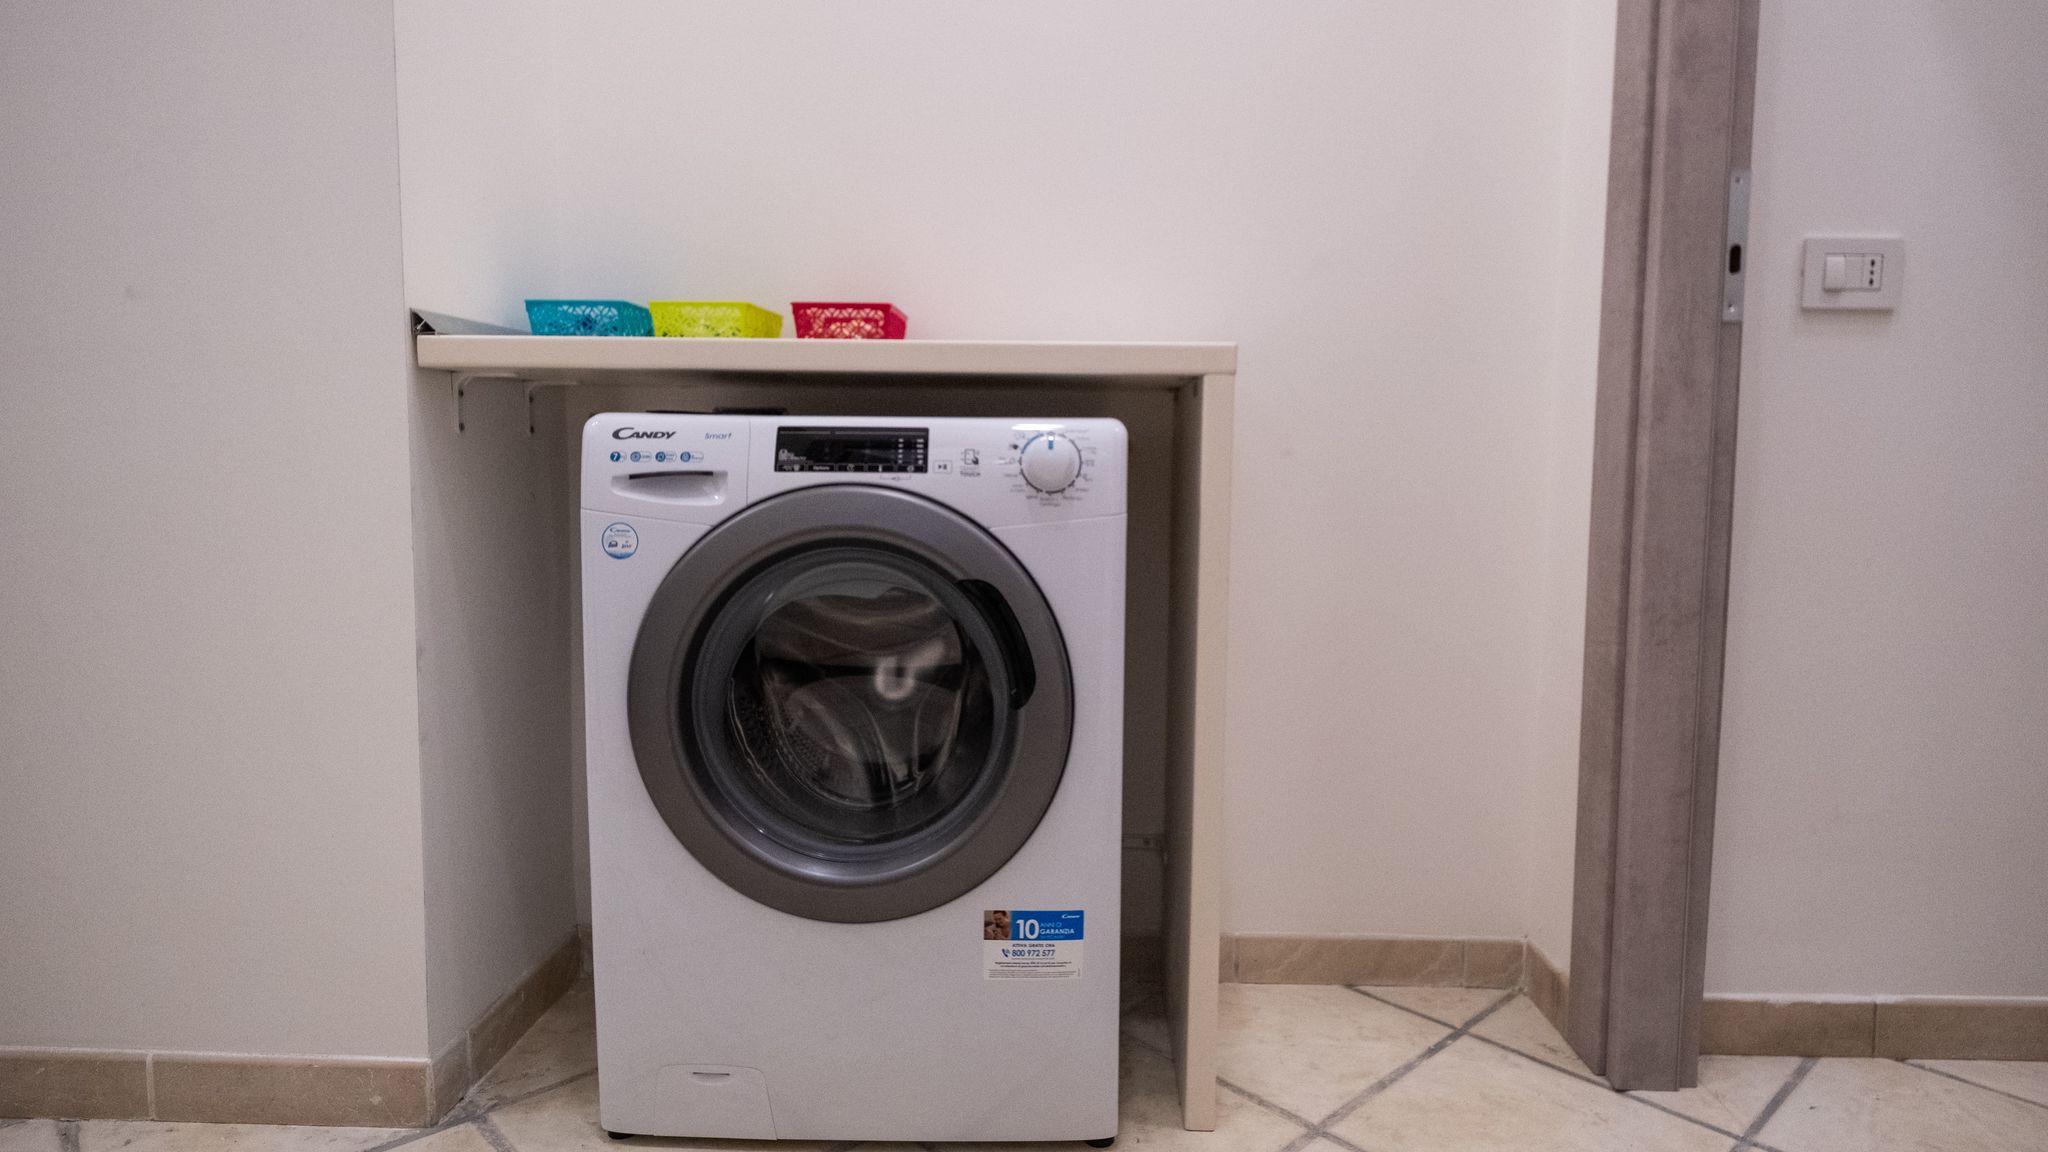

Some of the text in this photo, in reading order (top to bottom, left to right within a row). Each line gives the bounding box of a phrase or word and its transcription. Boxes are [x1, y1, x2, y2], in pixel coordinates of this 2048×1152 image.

[612, 427, 676, 440] CANDY
[1016, 919, 1039, 939] 10
[1012, 949, 1055, 957] 800 972 577
